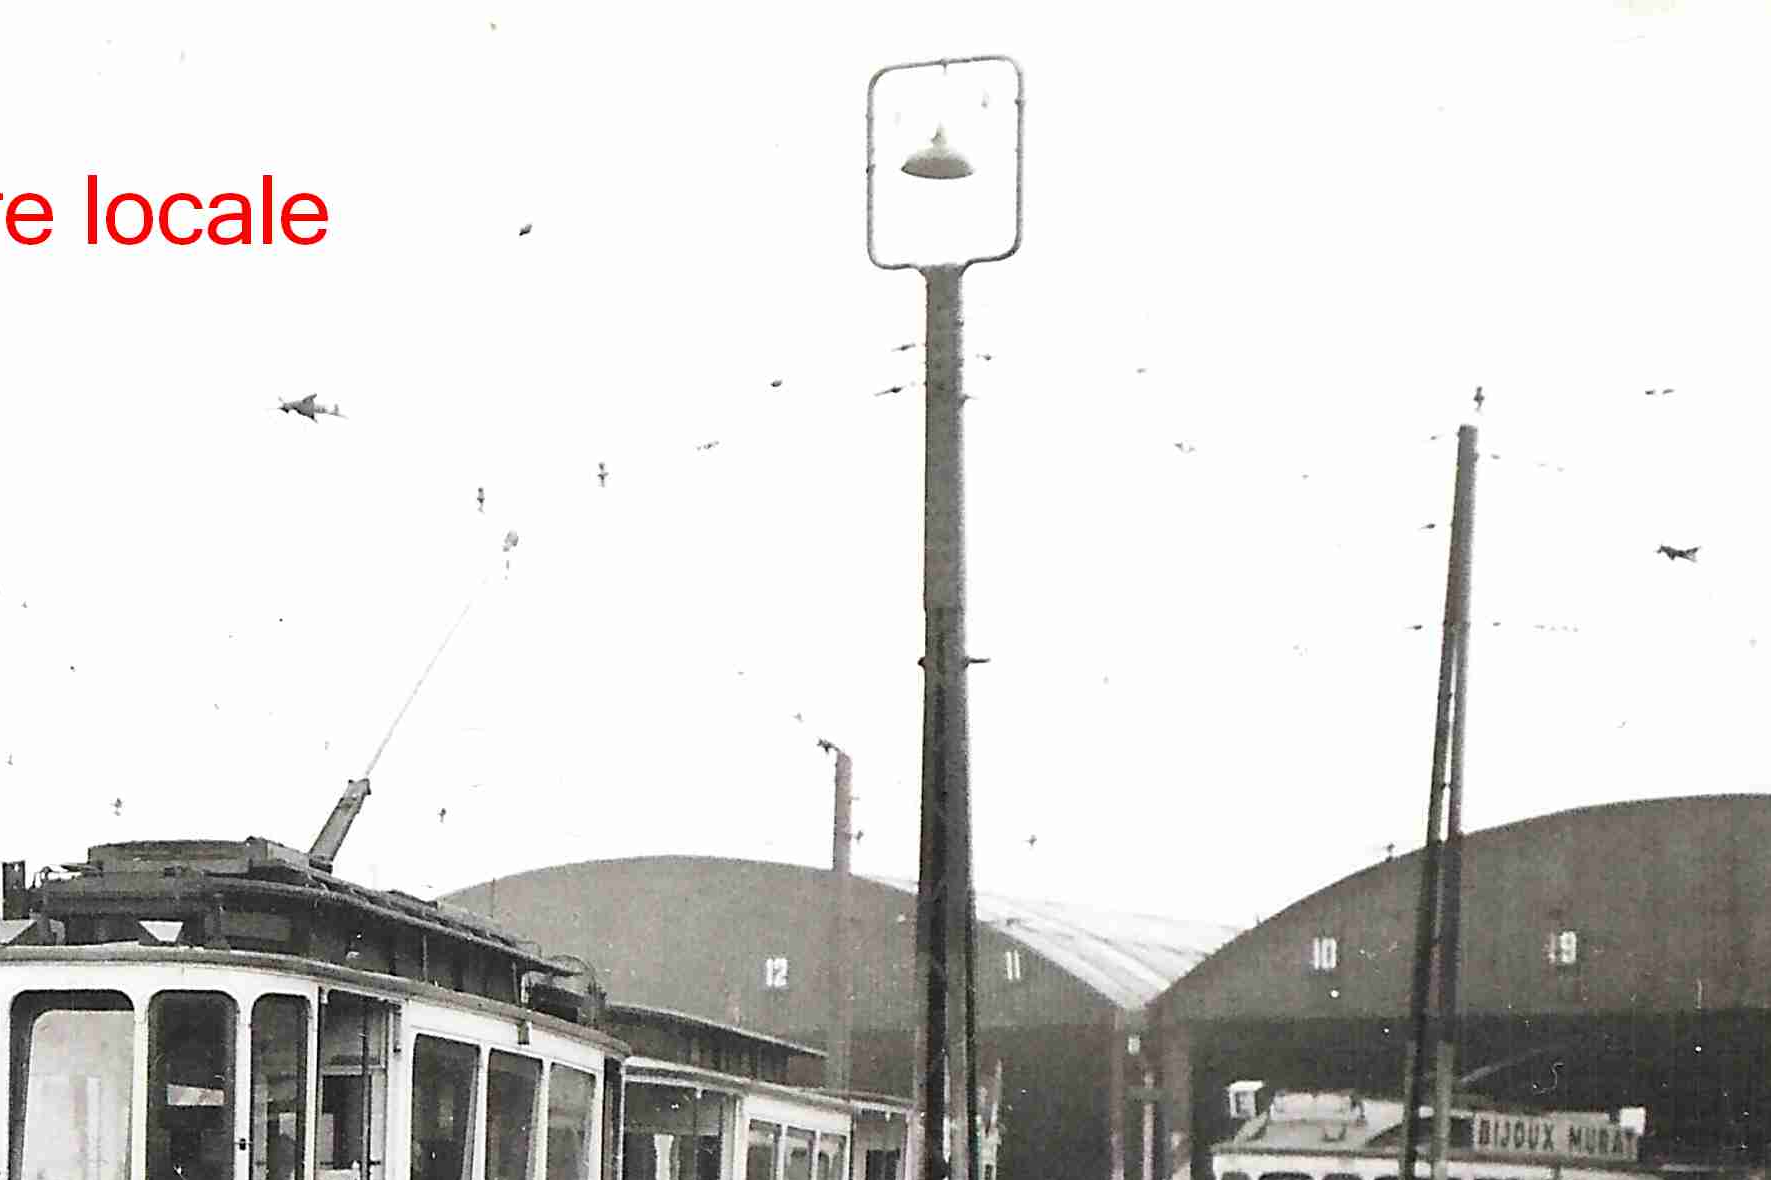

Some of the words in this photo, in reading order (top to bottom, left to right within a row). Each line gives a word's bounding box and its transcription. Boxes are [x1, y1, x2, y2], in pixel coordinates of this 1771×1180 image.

[1313, 937, 1337, 970] 10
[765, 957, 788, 987] 12
[1479, 1118, 1555, 1152] BIJOUX
